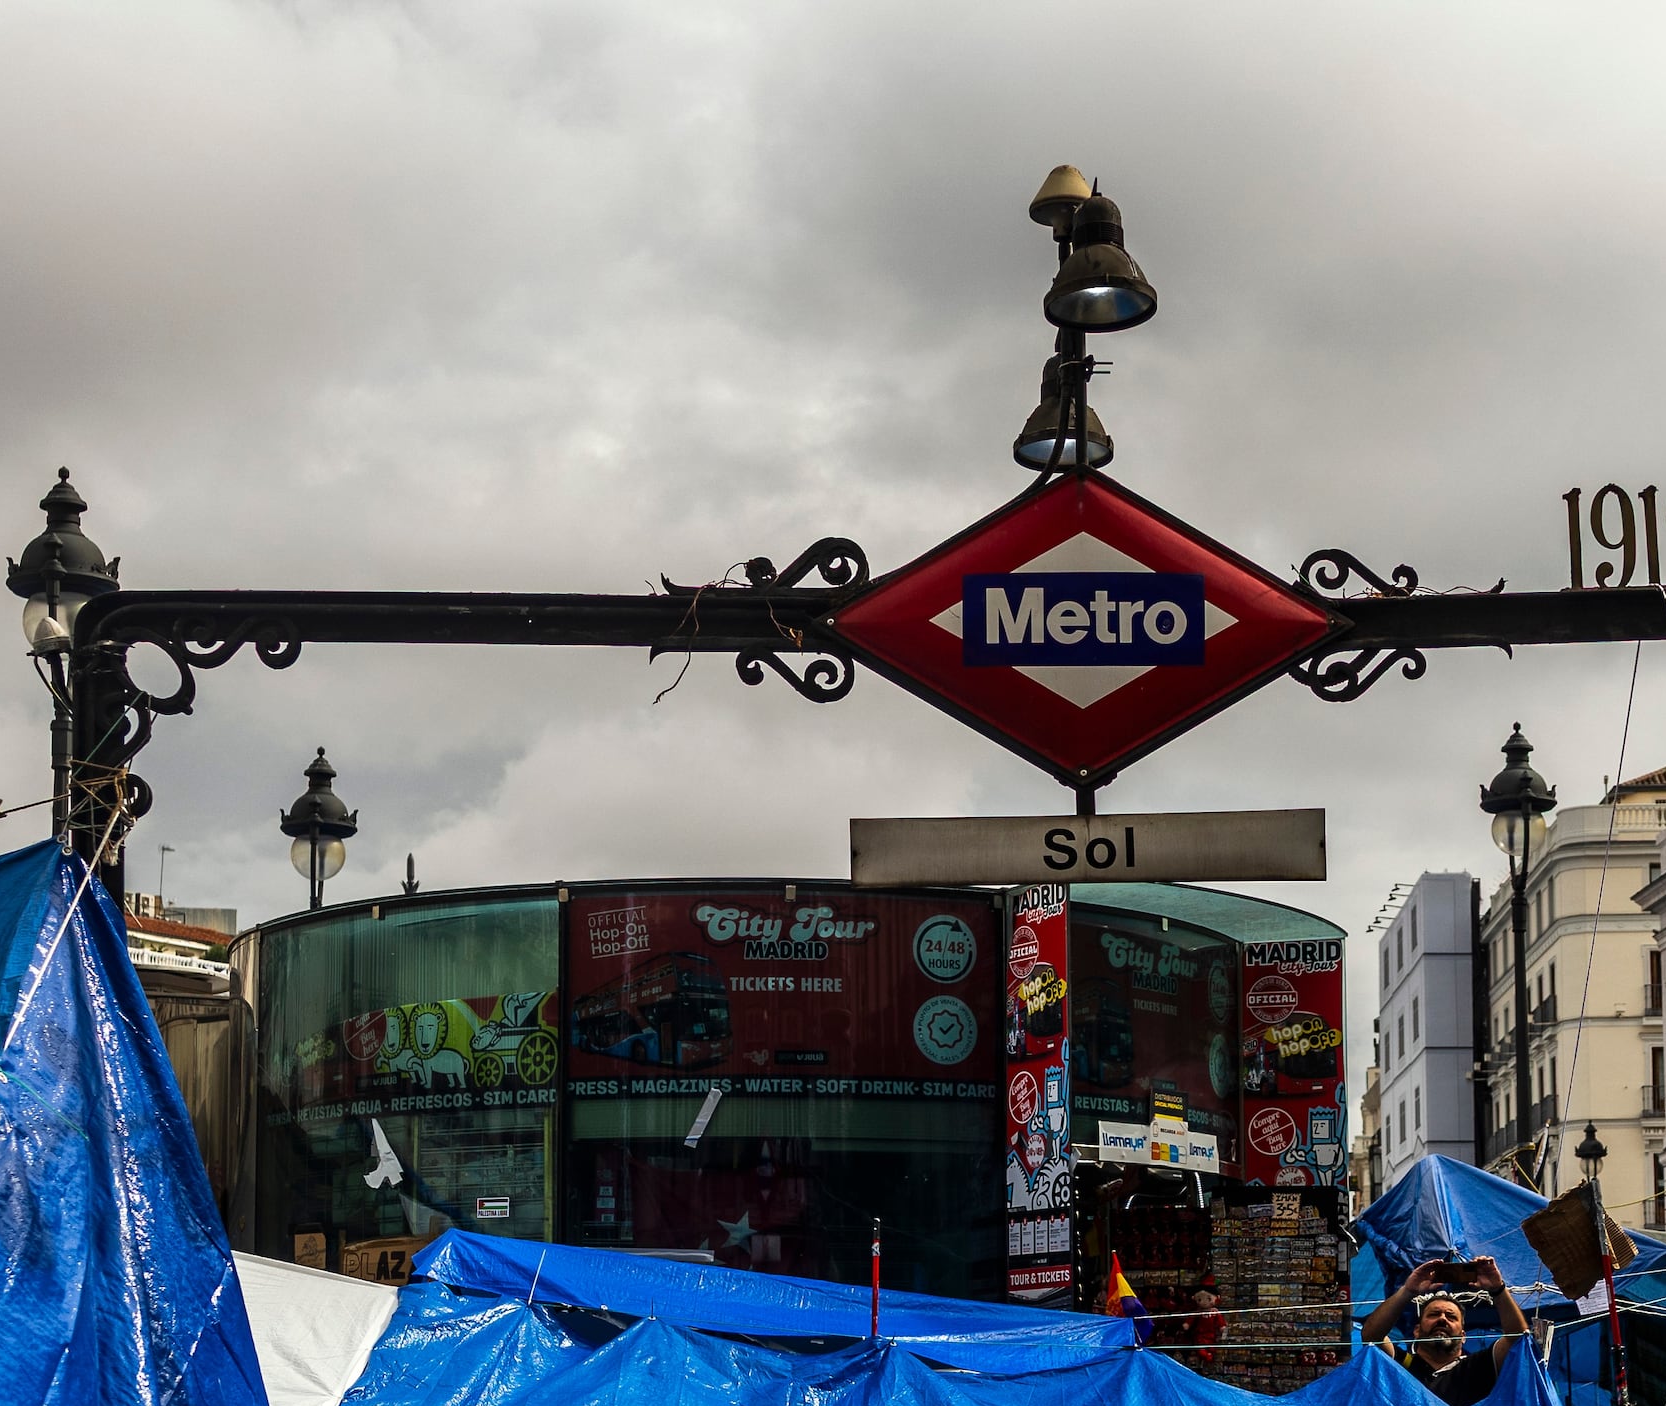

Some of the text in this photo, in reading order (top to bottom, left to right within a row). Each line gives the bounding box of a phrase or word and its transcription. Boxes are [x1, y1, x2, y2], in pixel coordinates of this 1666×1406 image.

[985, 587, 1187, 645] Metro
[1043, 827, 1136, 870] Sol
[1014, 884, 1067, 916] ADRID
[588, 910, 647, 927] OFFICIAL
[696, 906, 874, 942] City Tour
[589, 923, 647, 942] Hop-On
[591, 935, 650, 955] Hop-Off
[745, 941, 828, 960] MADRID
[1246, 940, 1342, 966] MADRID
[928, 958, 961, 970] HOURS
[1100, 933, 1198, 977] City Tour
[730, 976, 842, 992] TICKETS HERE
[1133, 972, 1178, 995] MADRID
[1133, 999, 1178, 1016] TICKETS HERE
[1249, 994, 1296, 1004] OFICIAL
[633, 1079, 732, 1094] MAGAZINES
[745, 1079, 803, 1093] WATER
[816, 1080, 858, 1094] SOFT
[924, 1081, 953, 1096] SIM
[298, 1104, 343, 1122] REVISTAS
[351, 1099, 382, 1114] AGUA
[391, 1092, 472, 1112] REFRESCOS
[484, 1091, 514, 1105] SIM
[1074, 1096, 1130, 1113] REVISTAS
[1253, 1112, 1281, 1129] Compre
[1266, 1133, 1284, 1146] Buy
[1270, 1140, 1288, 1153] here
[1010, 1270, 1070, 1287] TOUR & TICKETS
